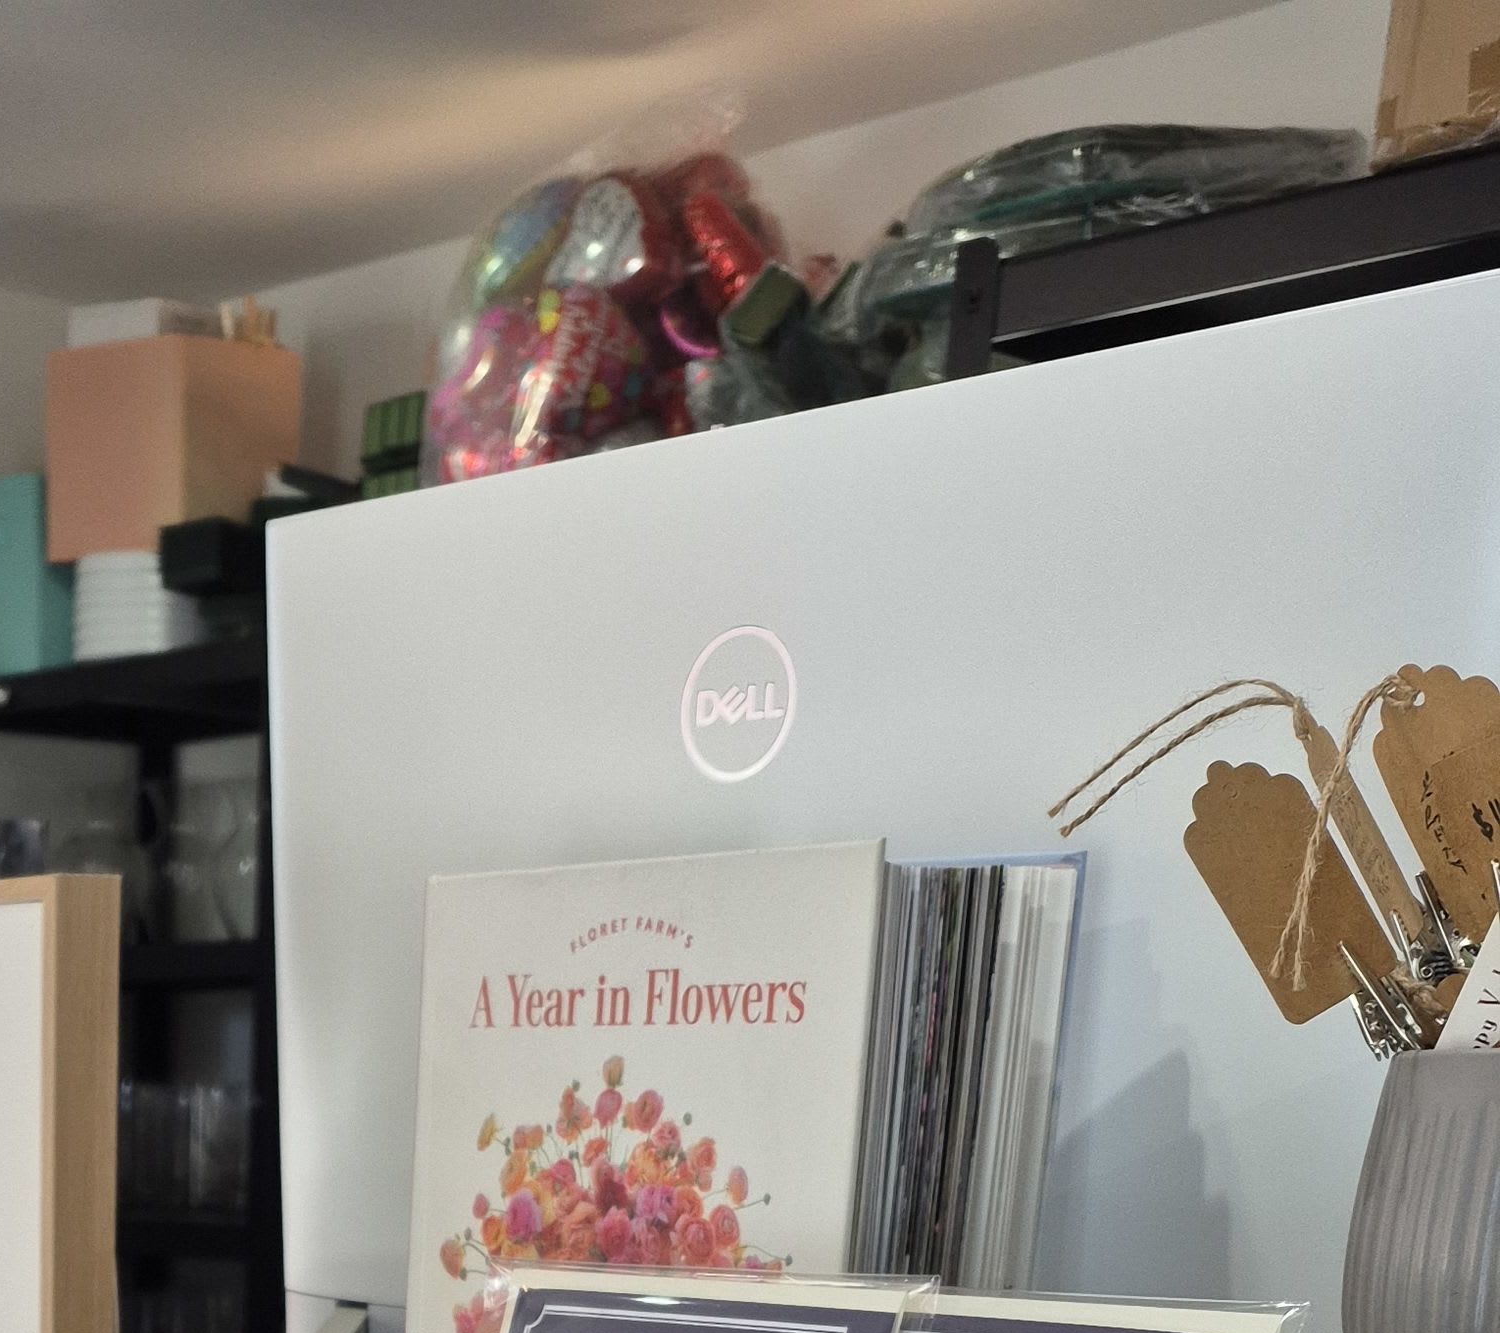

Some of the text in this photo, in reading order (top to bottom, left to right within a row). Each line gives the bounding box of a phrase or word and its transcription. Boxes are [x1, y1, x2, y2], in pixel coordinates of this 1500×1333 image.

[695, 682, 786, 729] DELL
[569, 916, 695, 954] FLORET FARM'S
[468, 968, 808, 1029] A Year in Flowers
